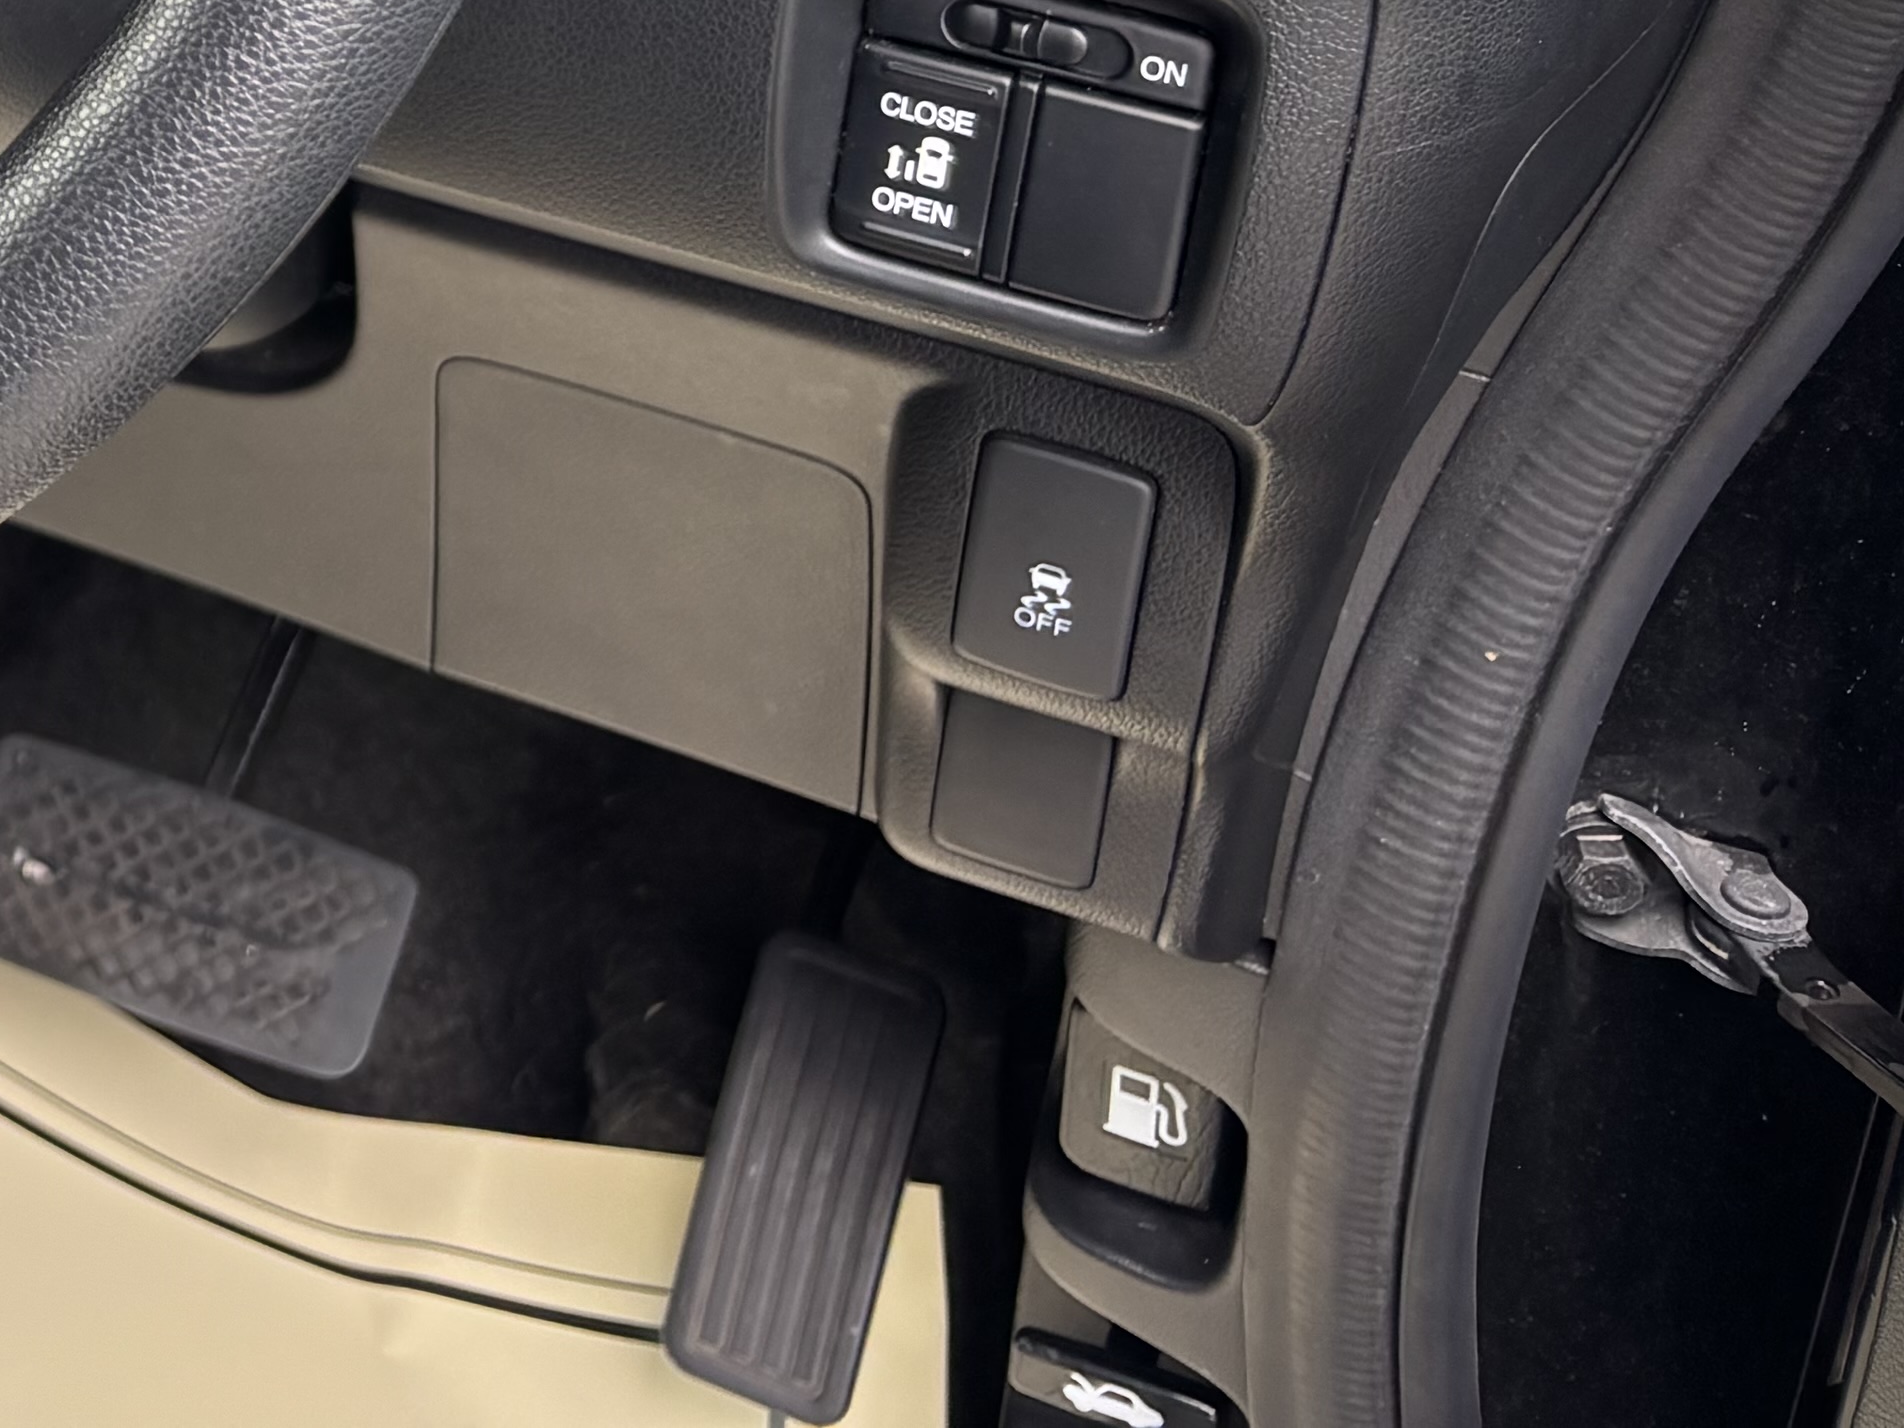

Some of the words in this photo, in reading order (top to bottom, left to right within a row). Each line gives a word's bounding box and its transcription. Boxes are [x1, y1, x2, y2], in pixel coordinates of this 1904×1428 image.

[1140, 55, 1188, 87] ON
[880, 91, 976, 137] CLOSE
[871, 186, 954, 229] OPEN
[1013, 606, 1073, 636] OFF
